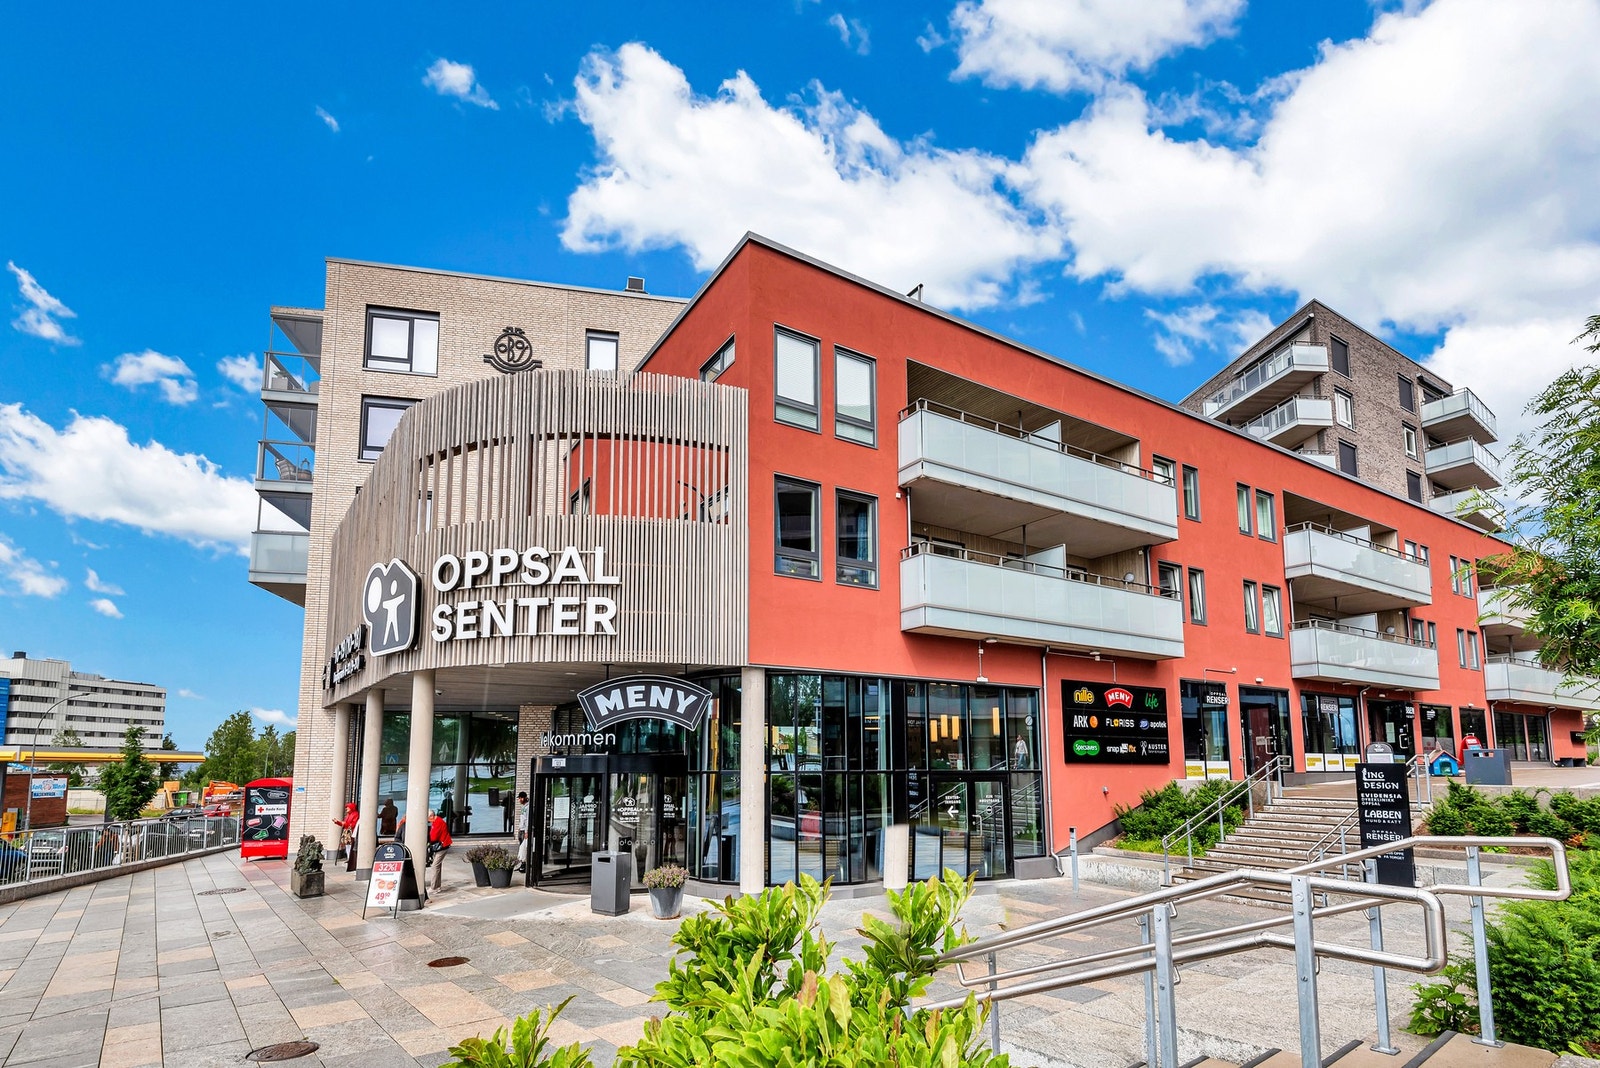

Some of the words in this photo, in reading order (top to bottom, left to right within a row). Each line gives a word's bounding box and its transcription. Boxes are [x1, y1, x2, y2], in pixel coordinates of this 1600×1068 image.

[431, 546, 621, 593] OPPSAL
[430, 597, 618, 643] SENTER
[593, 685, 698, 717] MENY
[1074, 687, 1094, 704] nille
[1108, 691, 1130, 703] MENY
[1144, 692, 1159, 710] life
[1073, 715, 1089, 728] ARK
[1105, 718, 1135, 728] FLORISS
[1363, 782, 1399, 790] DESIGN
[1364, 809, 1402, 820] LABBEN
